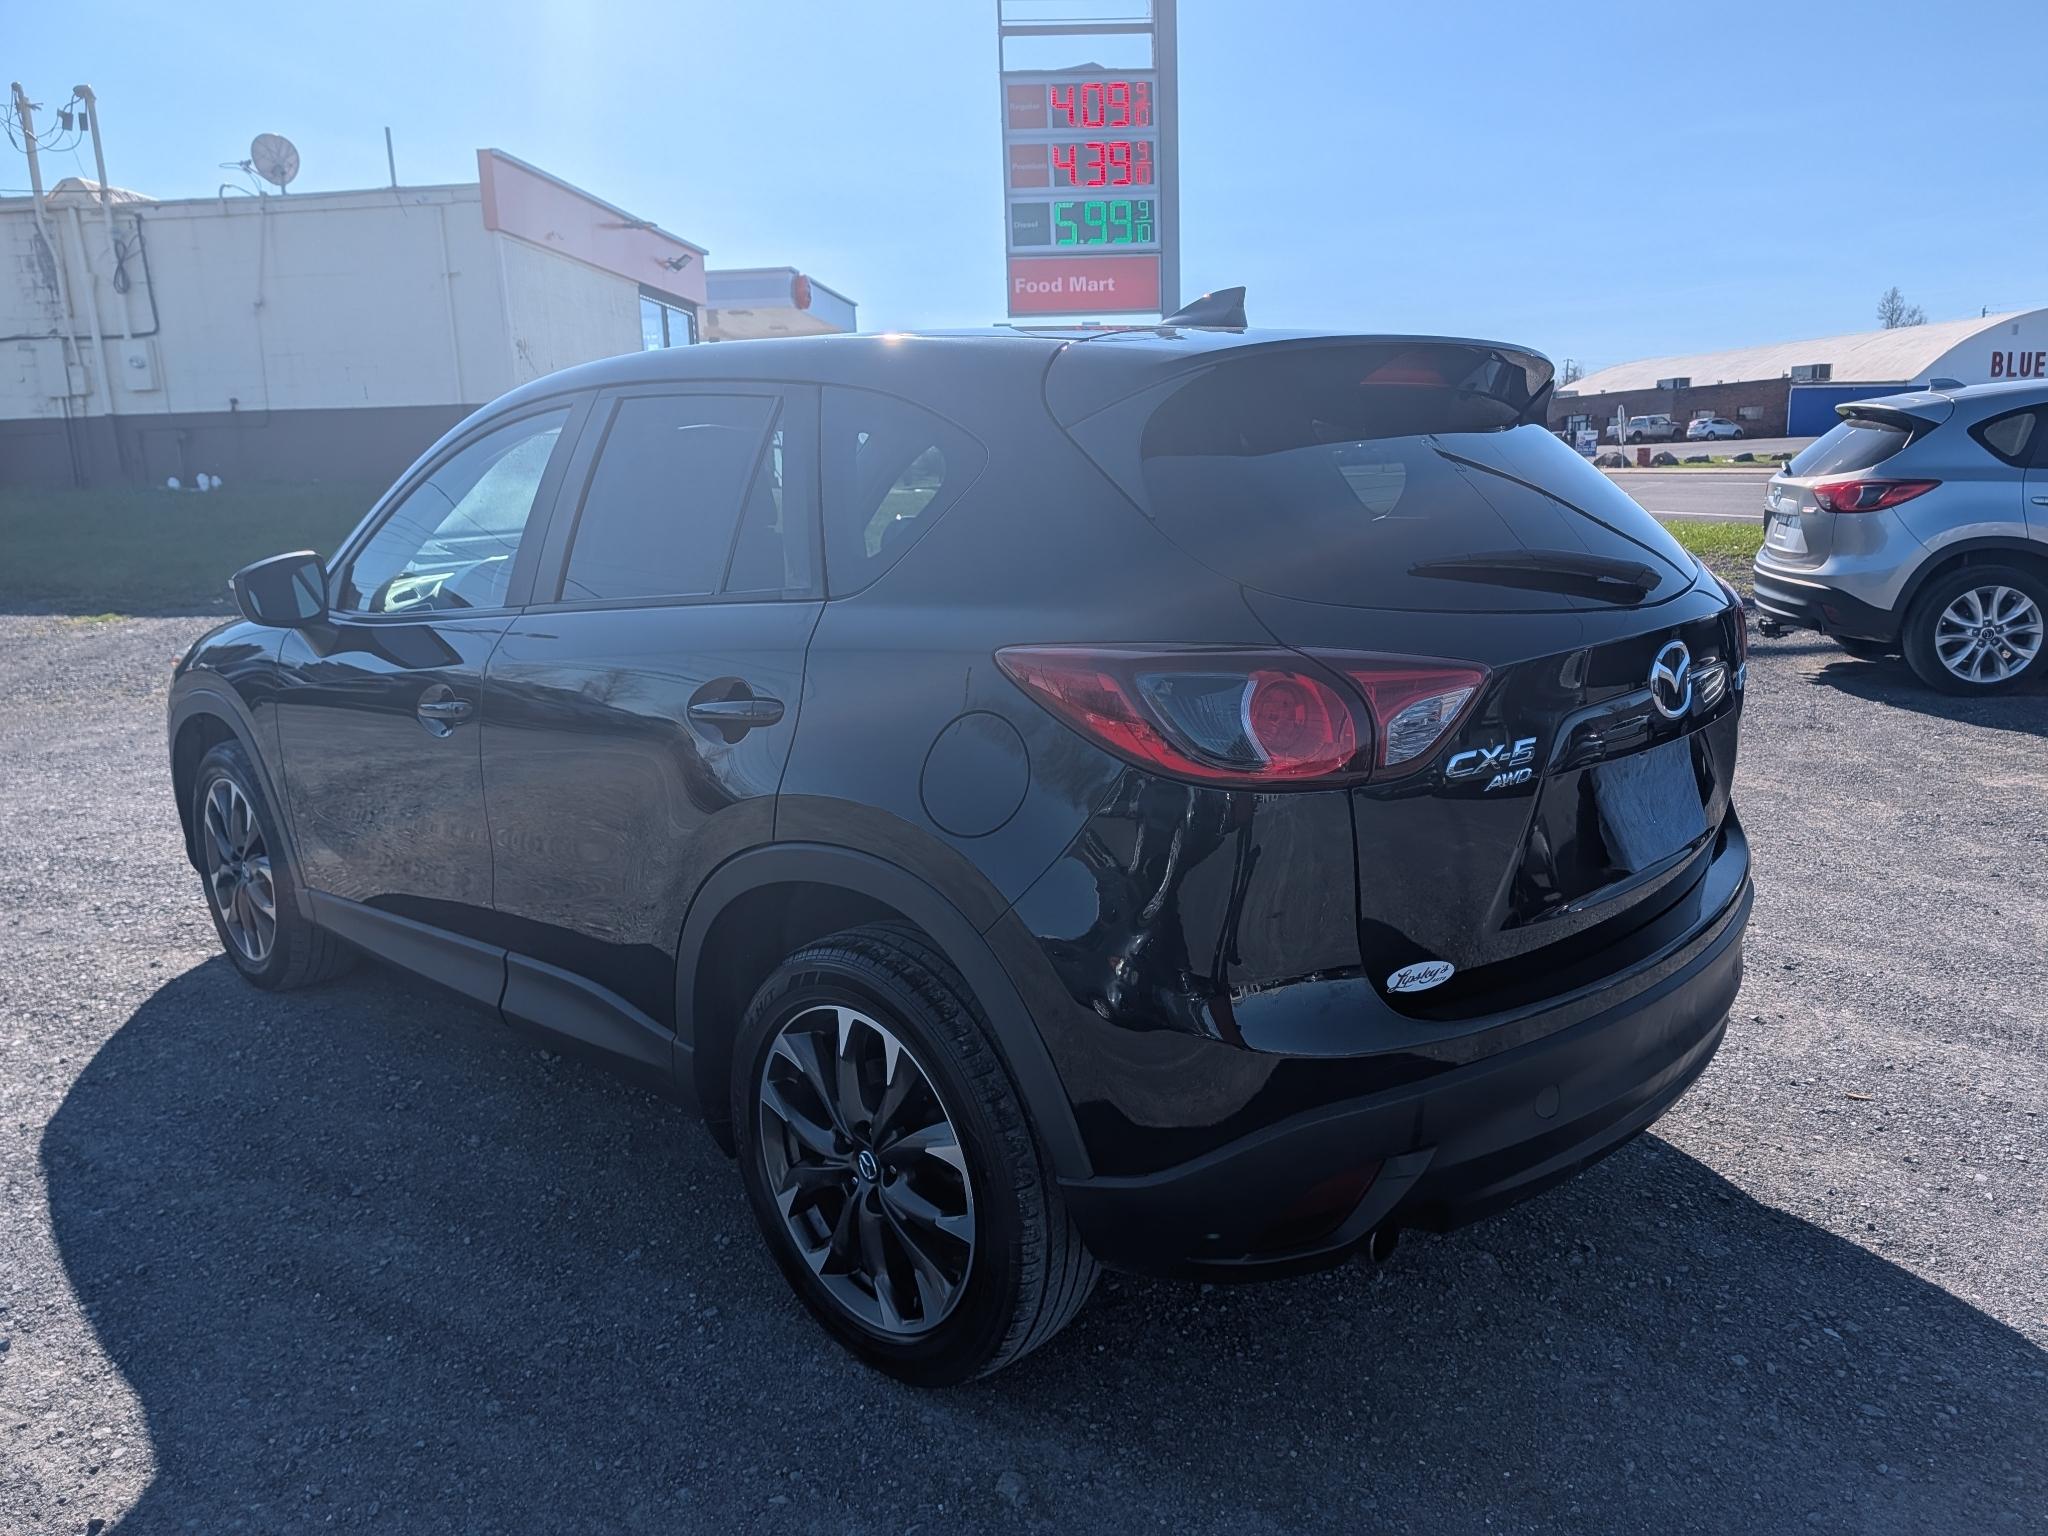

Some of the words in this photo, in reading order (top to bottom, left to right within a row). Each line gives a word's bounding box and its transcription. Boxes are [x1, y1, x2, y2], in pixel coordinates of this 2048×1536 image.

[1055, 200, 1133, 246] 5.99
[1015, 277, 1062, 293] Food
[1069, 275, 1116, 292] Mart
[1990, 351, 2047, 378] BLUE
[1446, 737, 1537, 778] CX-5
[1483, 768, 1533, 792] AWD
